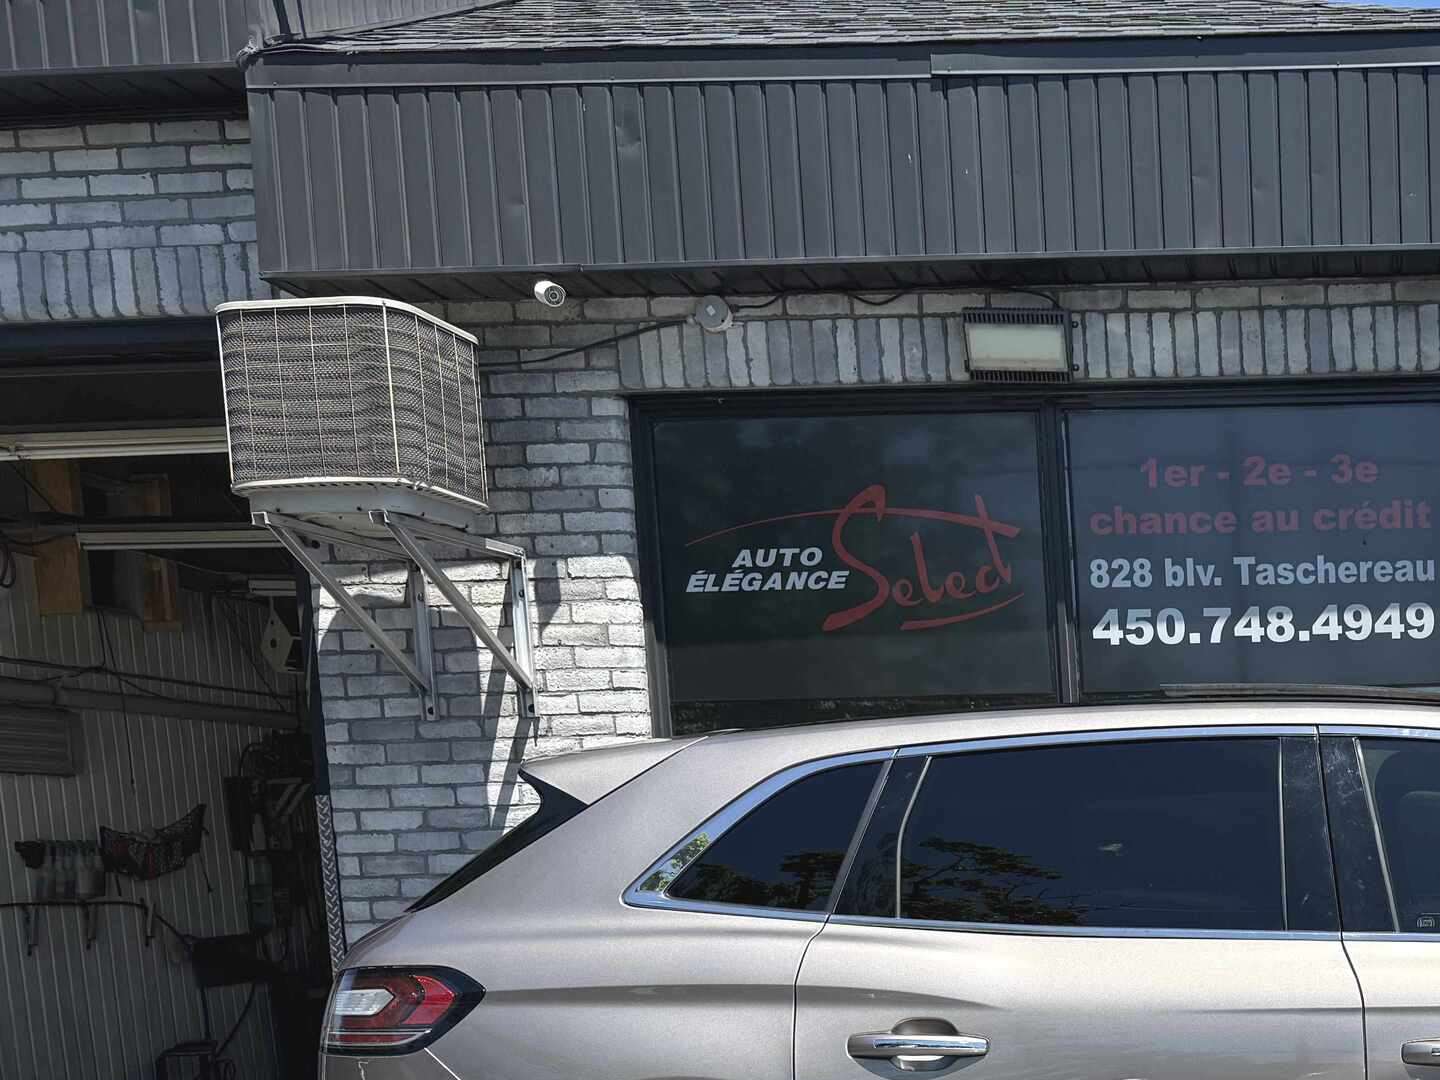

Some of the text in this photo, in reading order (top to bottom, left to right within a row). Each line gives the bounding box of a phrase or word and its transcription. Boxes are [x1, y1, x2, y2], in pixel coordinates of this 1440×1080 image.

[1140, 453, 1379, 488] 1er - 2e - 3e
[1089, 498, 1432, 535] chance au crédit
[732, 547, 823, 568] AUTO
[821, 483, 1021, 632] Select
[1089, 554, 1436, 588] 828 blv. Taschereau
[685, 568, 850, 593] ÉLÉGANCE
[1092, 602, 1436, 646] 450.748.4949
